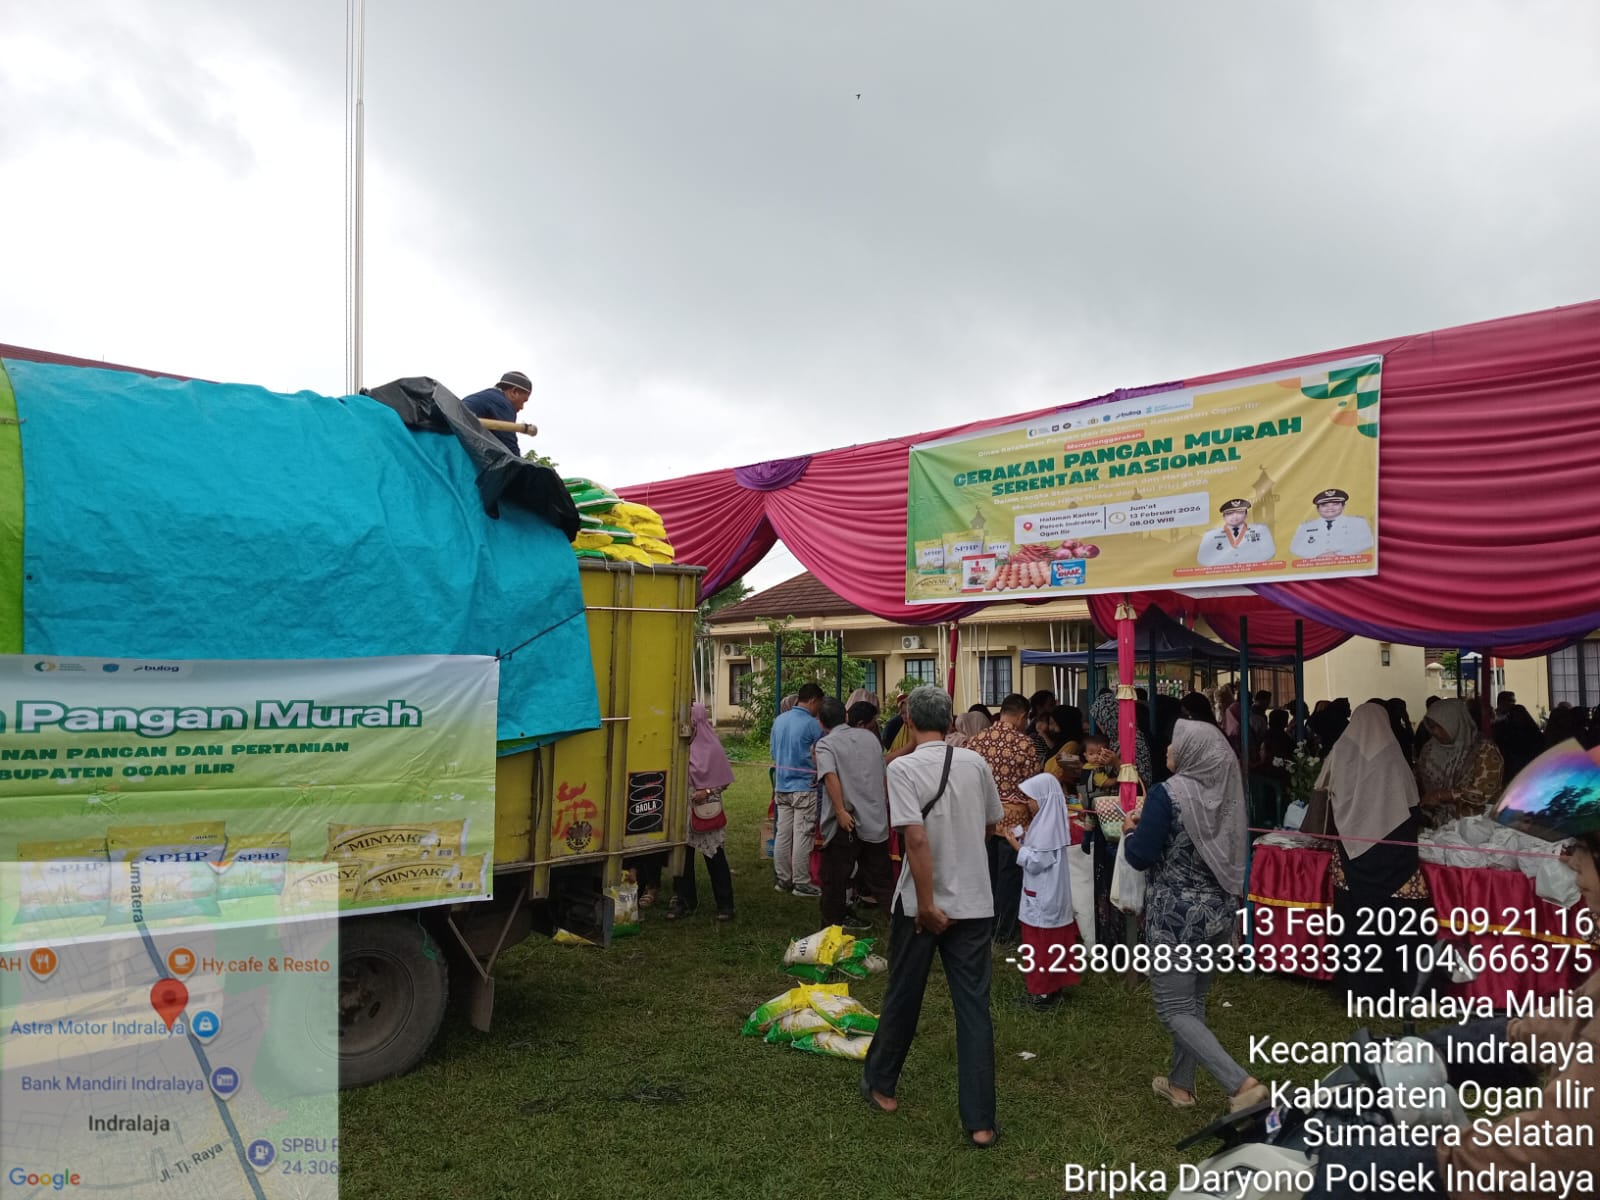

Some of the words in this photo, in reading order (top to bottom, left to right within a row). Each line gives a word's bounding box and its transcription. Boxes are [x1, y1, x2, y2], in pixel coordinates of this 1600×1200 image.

[953, 457, 1055, 487] GERAKAN
[1064, 437, 1173, 469] PANGAN
[1184, 416, 1302, 449] MURAH
[991, 467, 1099, 497] SERENTAK
[1109, 447, 1242, 479] NASIONAL
[1129, 503, 1157, 512] Jum'at
[1140, 508, 1177, 519] Februari
[1178, 505, 1202, 514] 2026
[1039, 513, 1071, 523] Halaman
[1072, 511, 1099, 519] Kantor
[144, 664, 180, 673] bulog
[17, 701, 248, 738] Pangan
[256, 700, 422, 729] Murah
[66, 746, 167, 760] PANGAN
[175, 744, 224, 758] DAN
[230, 742, 350, 756] PERTANIAN
[122, 763, 187, 777] OGAN
[194, 763, 236, 775] ILIR
[145, 851, 209, 864] SPHP
[238, 852, 281, 862] SPHP
